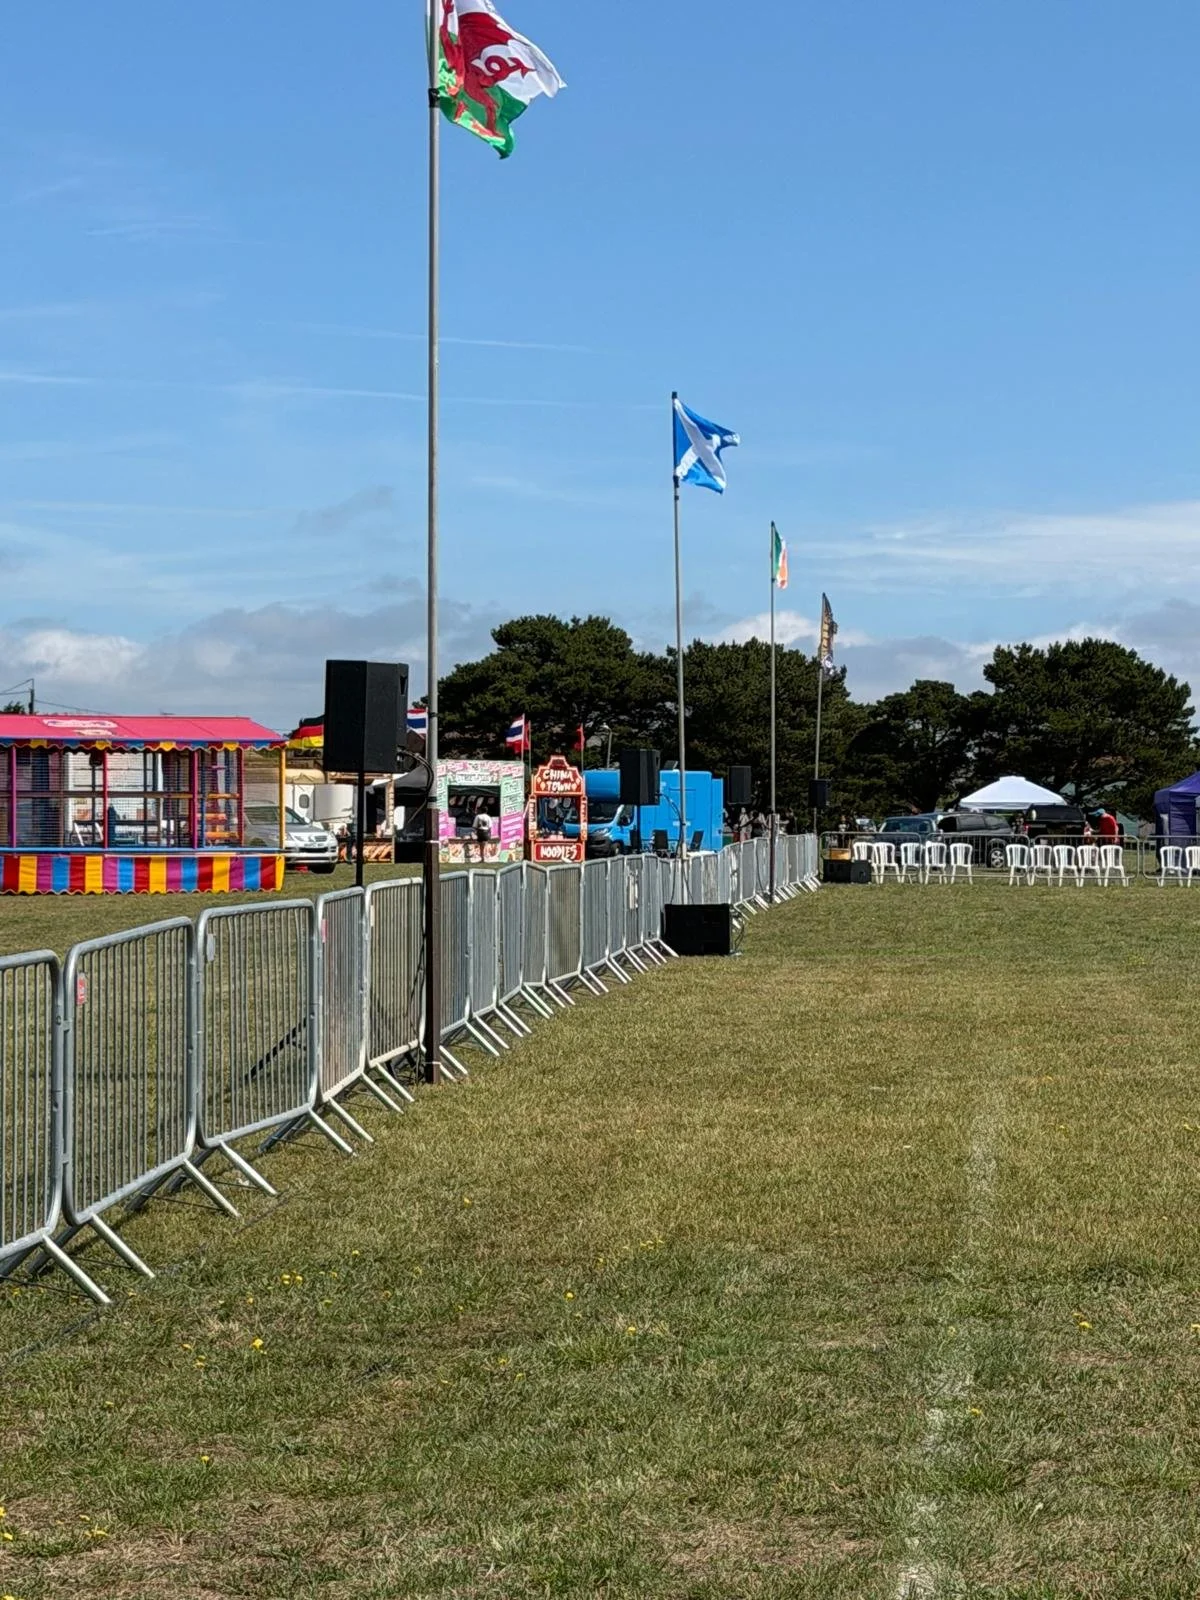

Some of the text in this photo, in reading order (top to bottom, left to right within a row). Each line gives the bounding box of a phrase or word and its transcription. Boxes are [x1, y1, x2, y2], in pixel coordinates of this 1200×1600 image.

[542, 769, 574, 781] CHINA
[546, 781, 572, 792] TOWN
[540, 844, 578, 863] NOODLES
